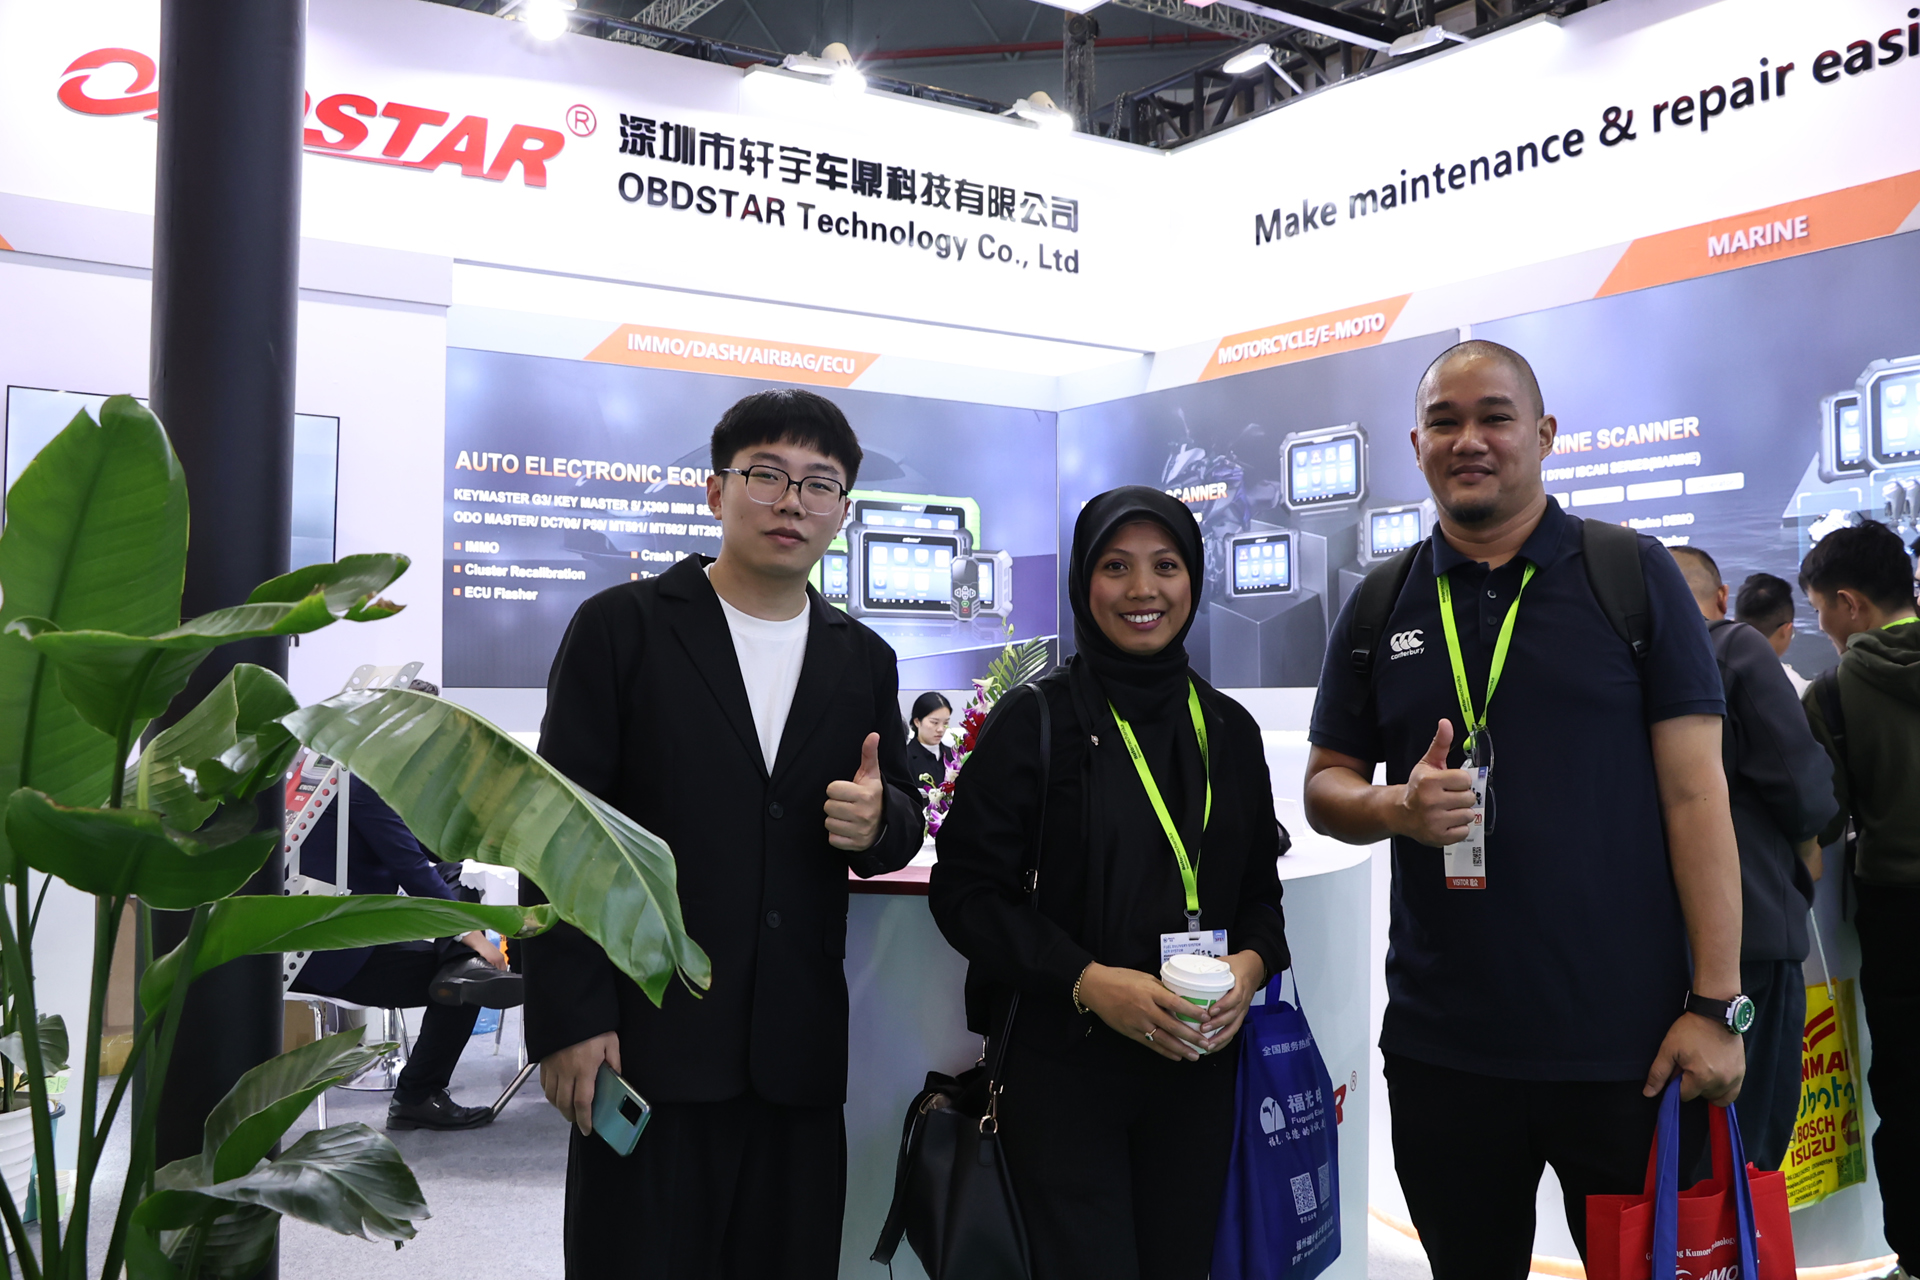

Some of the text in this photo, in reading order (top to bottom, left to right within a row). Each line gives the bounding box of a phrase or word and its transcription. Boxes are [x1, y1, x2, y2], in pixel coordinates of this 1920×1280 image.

[57, 47, 565, 188] OSTAR
[1255, 198, 1337, 245] Make
[1349, 127, 1584, 219] maintenance
[1599, 105, 1637, 147] &
[1653, 57, 1794, 132] repair
[619, 113, 1080, 233] 深圳市轩宇车鼎科技有限公司
[618, 172, 1080, 274] OBDSTAR Technology Co., Ltd
[1707, 215, 1809, 257] MARINE
[628, 333, 856, 375] IMMO/DASH/AIRBAG/ECU
[1218, 313, 1386, 364] MOTORCYCLE/E-MOTO
[1550, 416, 1701, 455] RINE SCANNER
[455, 450, 519, 474] AUTO
[525, 455, 661, 484] ELECTRONIC
[453, 488, 530, 505] KEYMASTER
[553, 495, 579, 508] KEY
[580, 497, 629, 511] MASTER
[453, 511, 482, 524] ODO
[484, 512, 539, 528] MASTER/
[465, 541, 500, 554] IMMO
[641, 549, 674, 562] Crash
[464, 563, 586, 581] Cluster Recalibration
[464, 586, 538, 601] ECU Flasher
[1390, 647, 1425, 660] canterbury
[1801, 1049, 1849, 1082] NMA
[1800, 1076, 1856, 1119] ubota
[1797, 1115, 1836, 1144] BOSCH
[1791, 1135, 1836, 1167] ISUZU
